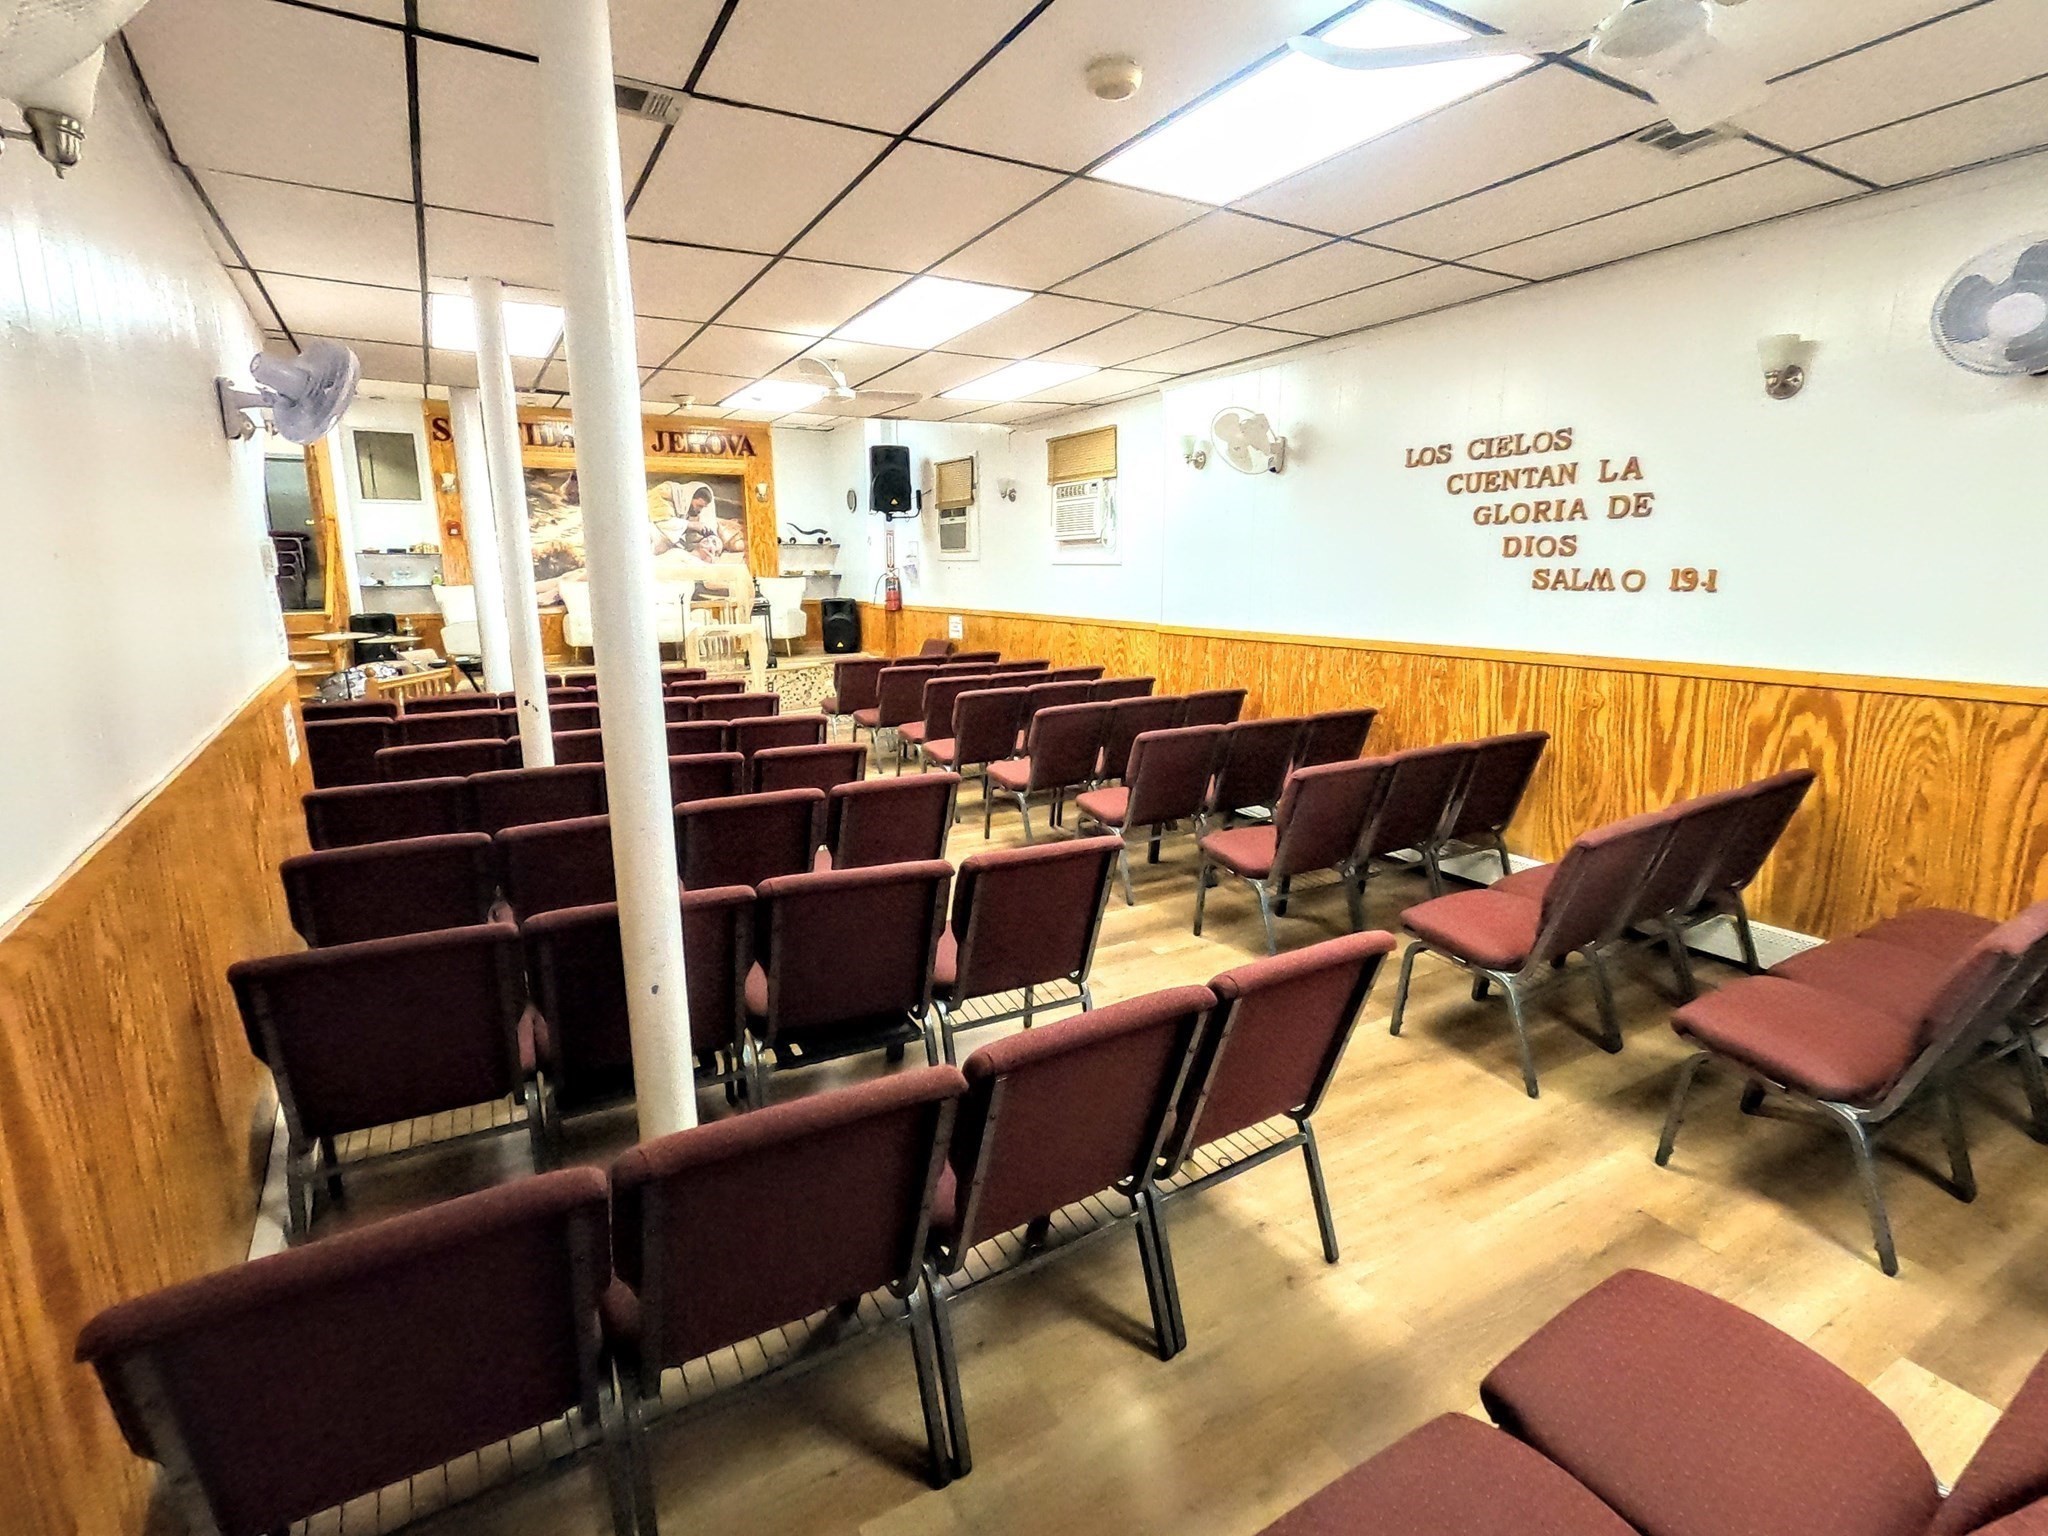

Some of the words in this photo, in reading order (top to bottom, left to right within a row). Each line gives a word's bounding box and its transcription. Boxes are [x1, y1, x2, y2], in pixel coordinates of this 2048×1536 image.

[651, 430, 757, 457] JEHOVA
[1404, 444, 1452, 468] LOS
[1467, 427, 1573, 461] CIELOS
[1446, 462, 1579, 495] CUENTAN
[1597, 456, 1644, 483] LA
[1473, 498, 1588, 526] GLORIA
[1606, 492, 1655, 520] DE
[1502, 535, 1578, 558] DIOS
[1532, 568, 1647, 593] SALMO
